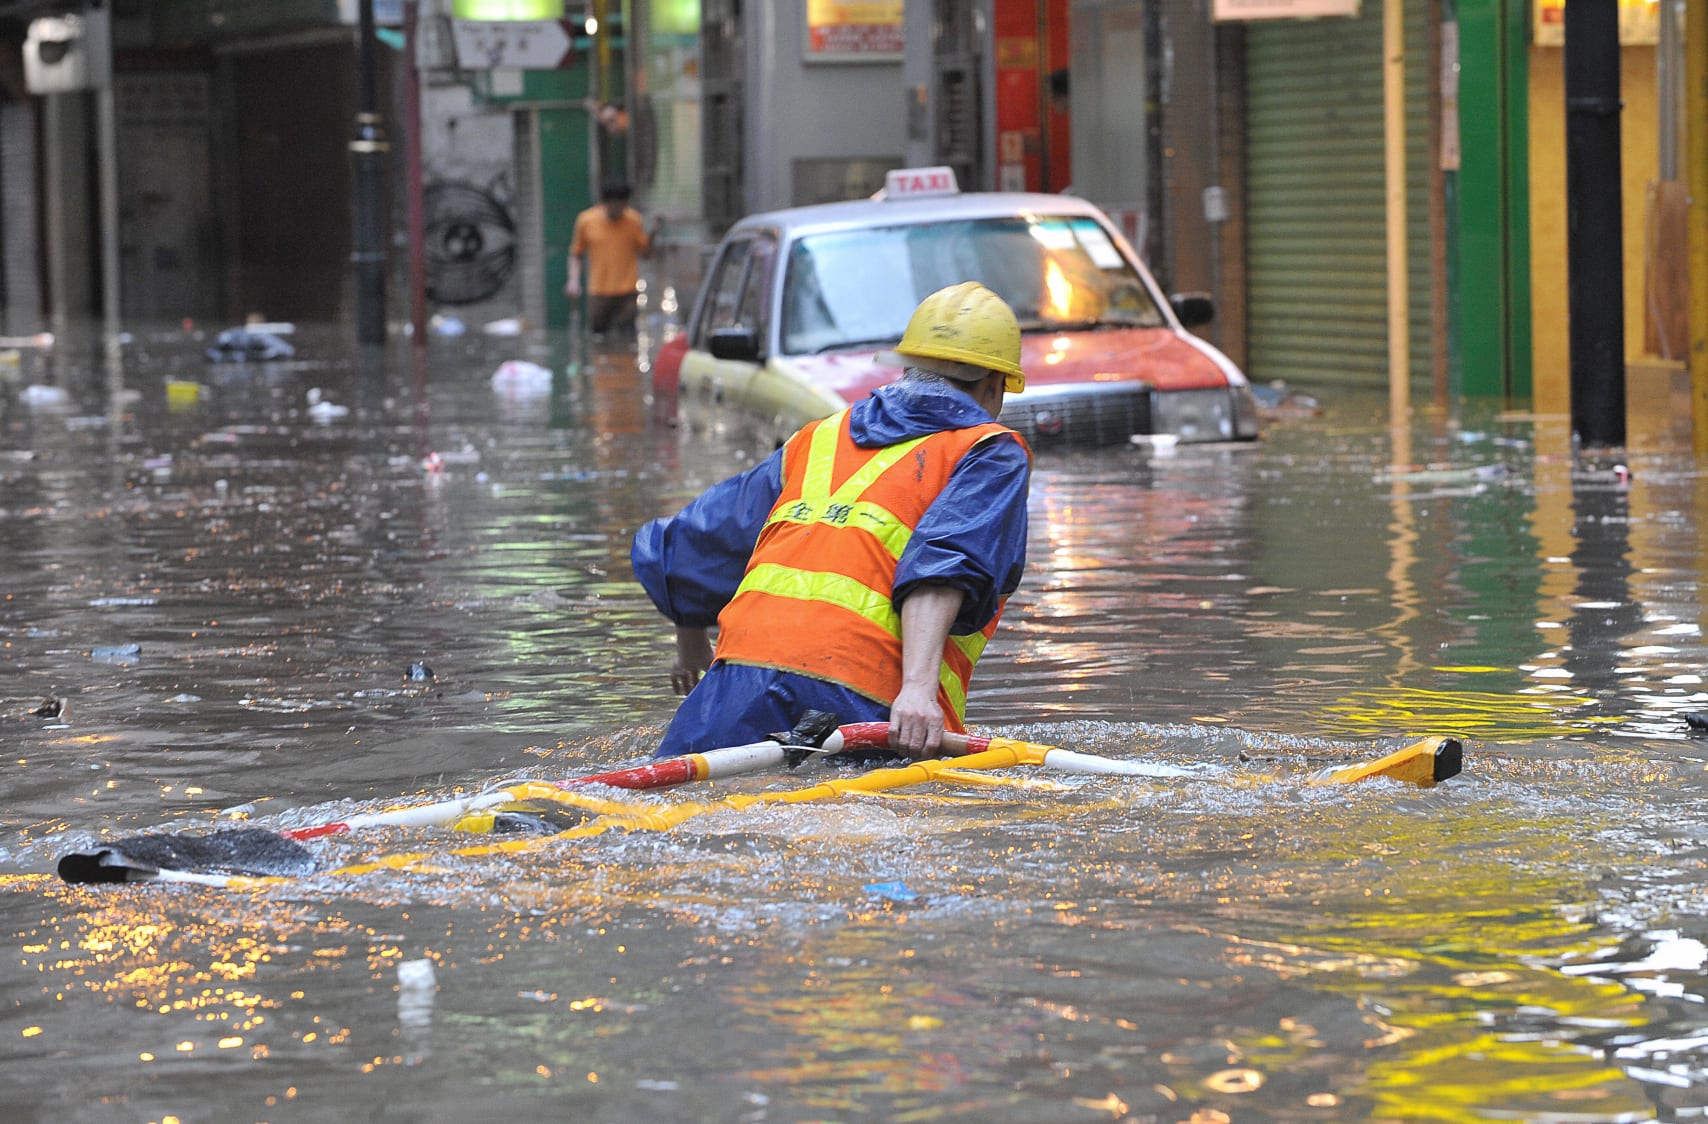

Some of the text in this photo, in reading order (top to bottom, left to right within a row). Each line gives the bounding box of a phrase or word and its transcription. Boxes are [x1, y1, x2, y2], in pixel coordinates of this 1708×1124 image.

[896, 173, 949, 193] TAXI
[764, 502, 887, 527] 全第一
